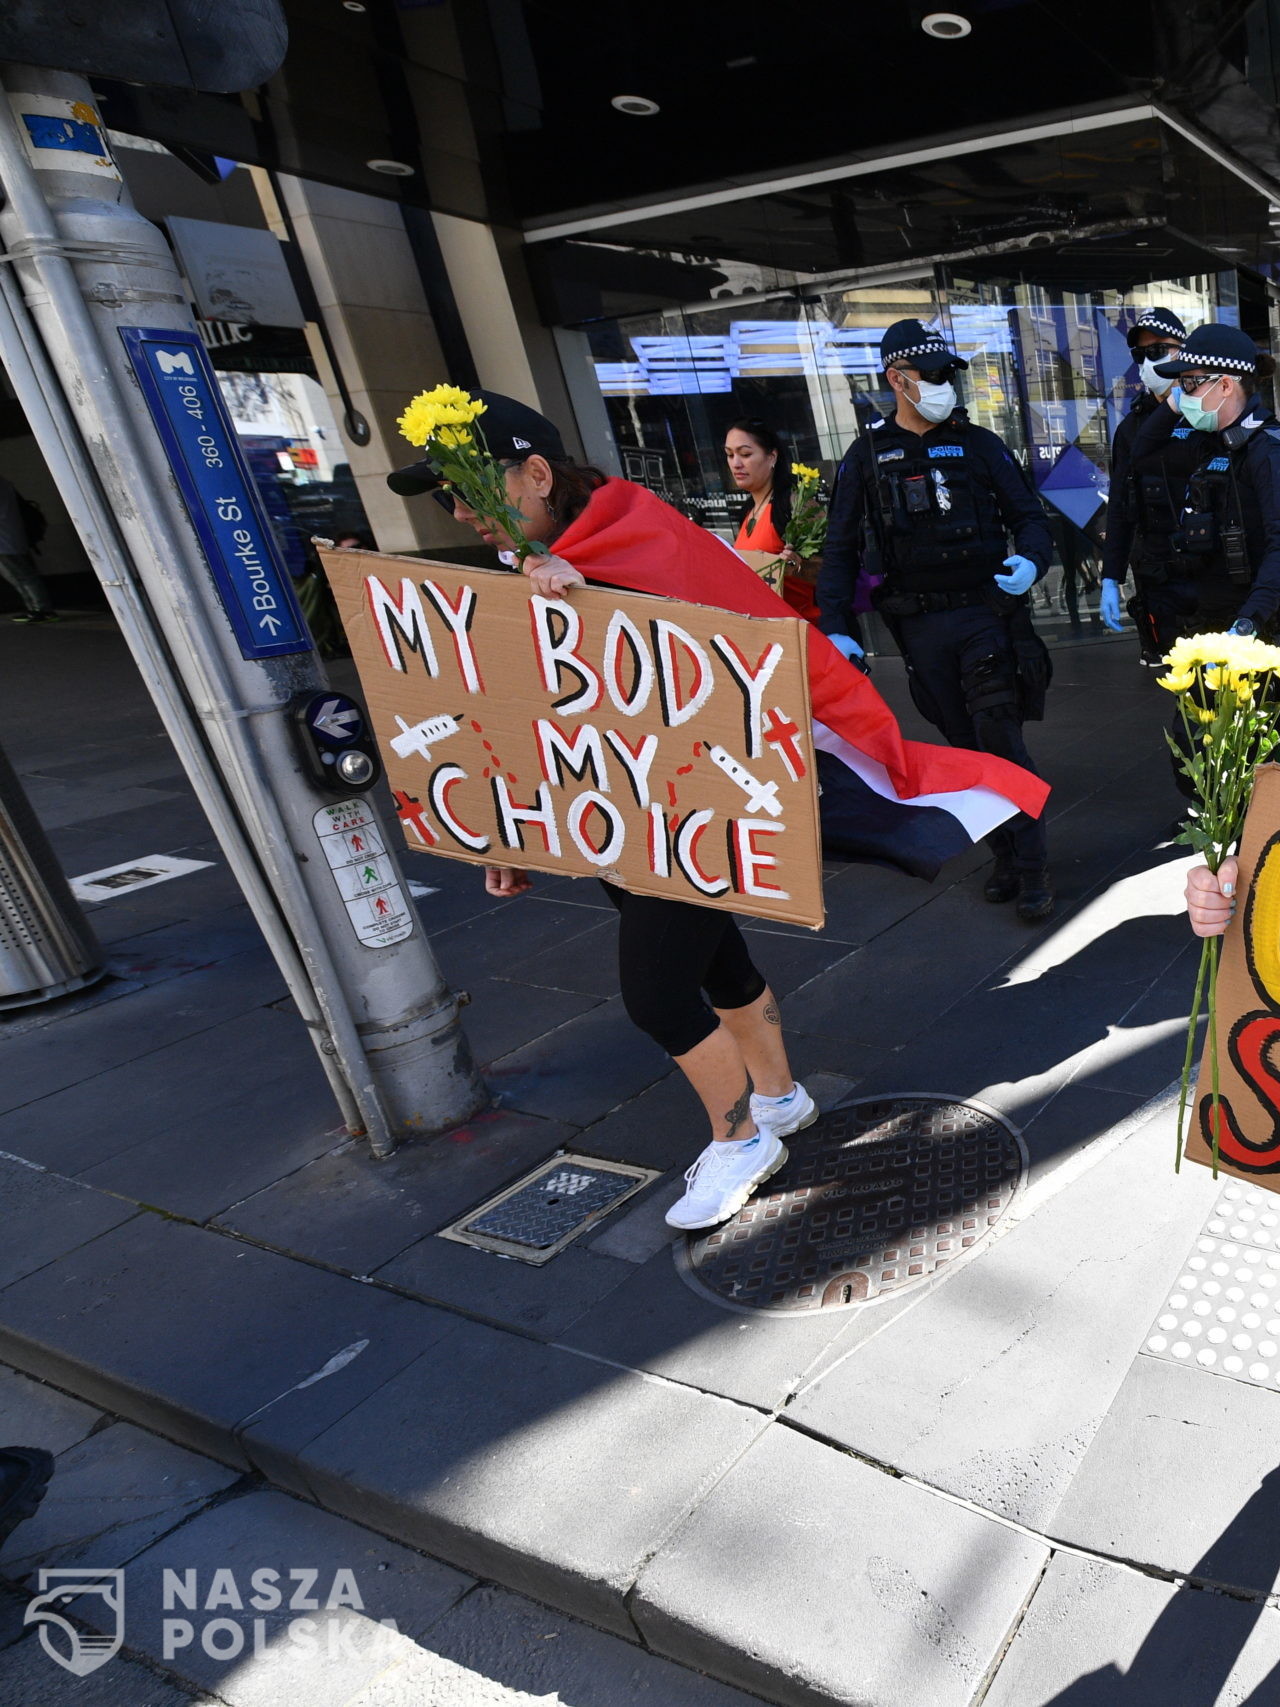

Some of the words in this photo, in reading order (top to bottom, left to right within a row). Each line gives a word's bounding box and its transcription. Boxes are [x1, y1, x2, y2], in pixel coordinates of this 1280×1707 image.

[178, 384, 205, 421] 406
[196, 434, 224, 469] 360
[214, 495, 243, 522] St
[232, 528, 278, 611] Bourke
[364, 574, 486, 696] MY
[528, 593, 784, 759] BODY
[532, 719, 659, 809] MY
[325, 802, 359, 816] WALK
[332, 810, 361, 823] WITH
[332, 816, 366, 831] CARE
[427, 762, 791, 900] CHOICE
